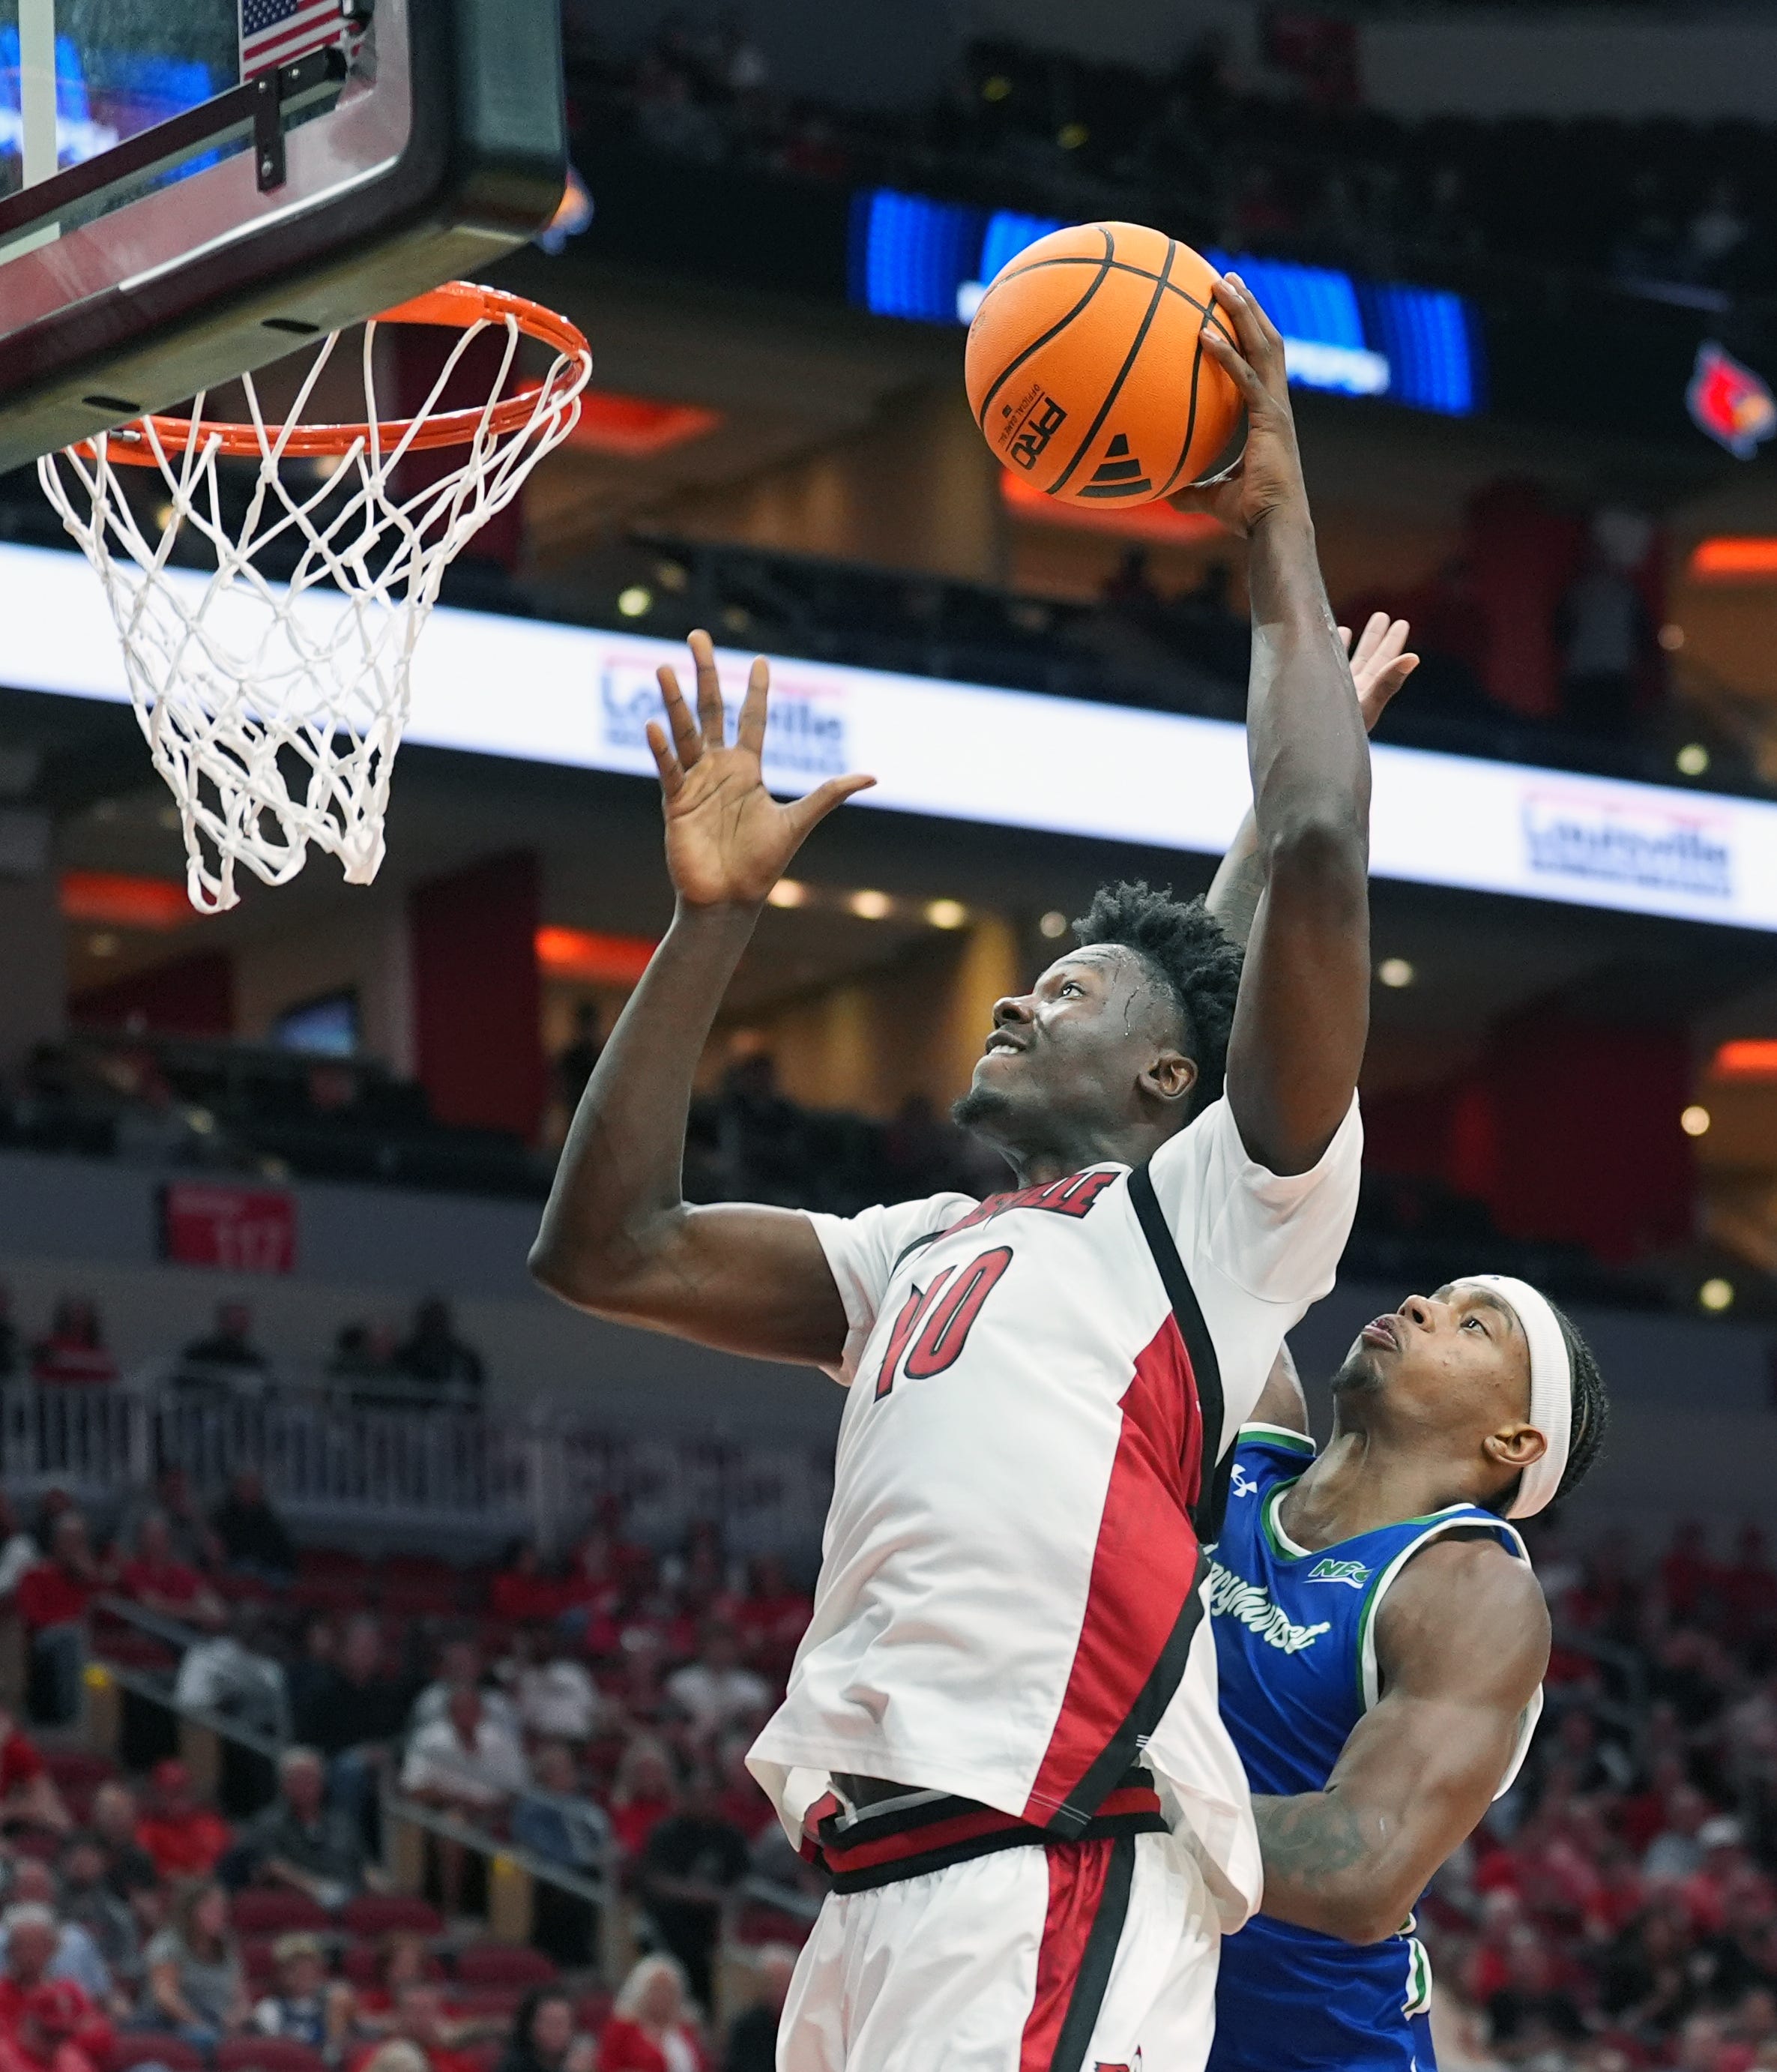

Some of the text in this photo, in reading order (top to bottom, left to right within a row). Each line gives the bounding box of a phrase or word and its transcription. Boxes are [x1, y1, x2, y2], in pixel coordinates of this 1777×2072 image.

[1016, 384, 1040, 415] OFFICIAL
[1010, 396, 1068, 470] PRO
[874, 1245, 1013, 1403] 10
[1307, 1558, 1374, 1583] NEC
